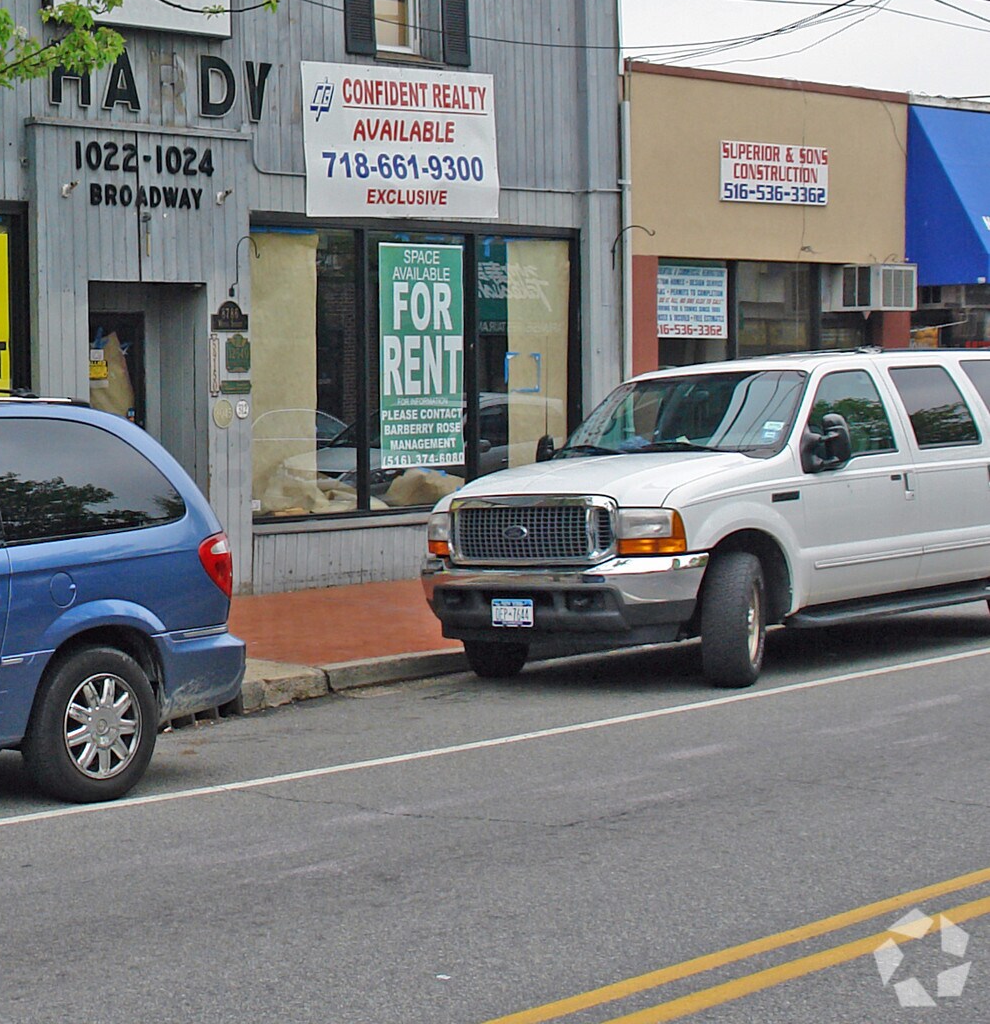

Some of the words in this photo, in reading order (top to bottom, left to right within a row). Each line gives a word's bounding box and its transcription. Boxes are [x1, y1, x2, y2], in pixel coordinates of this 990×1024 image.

[342, 78, 428, 107] CONFIDENT
[432, 84, 487, 110] REALTY
[353, 118, 456, 143] AVAILABLE
[75, 141, 215, 177] 1022-1024
[722, 142, 780, 162] SUPERIOR
[785, 147, 795, 163] &
[799, 148, 828, 165] SONS
[321, 151, 485, 182] 718-661-9300
[733, 163, 818, 184] CONSTRUCTION
[90, 183, 203, 210] BROADWAY
[366, 189, 448, 205] EXCLUSIVE
[724, 183, 826, 203] 516-536-3362
[403, 250, 440, 265] SPACE
[392, 266, 451, 282] AVAILABLE
[392, 282, 453, 331] FOR
[383, 335, 463, 396] RENT
[382, 409, 418, 421] PLEASE
[420, 408, 463, 419] CONTACT
[384, 423, 434, 435] BARBERRY
[437, 422, 461, 433] ROSE
[390, 438, 456, 451] MANAGEMENT
[383, 454, 412, 467] (516)
[415, 453, 464, 465] 374-6080
